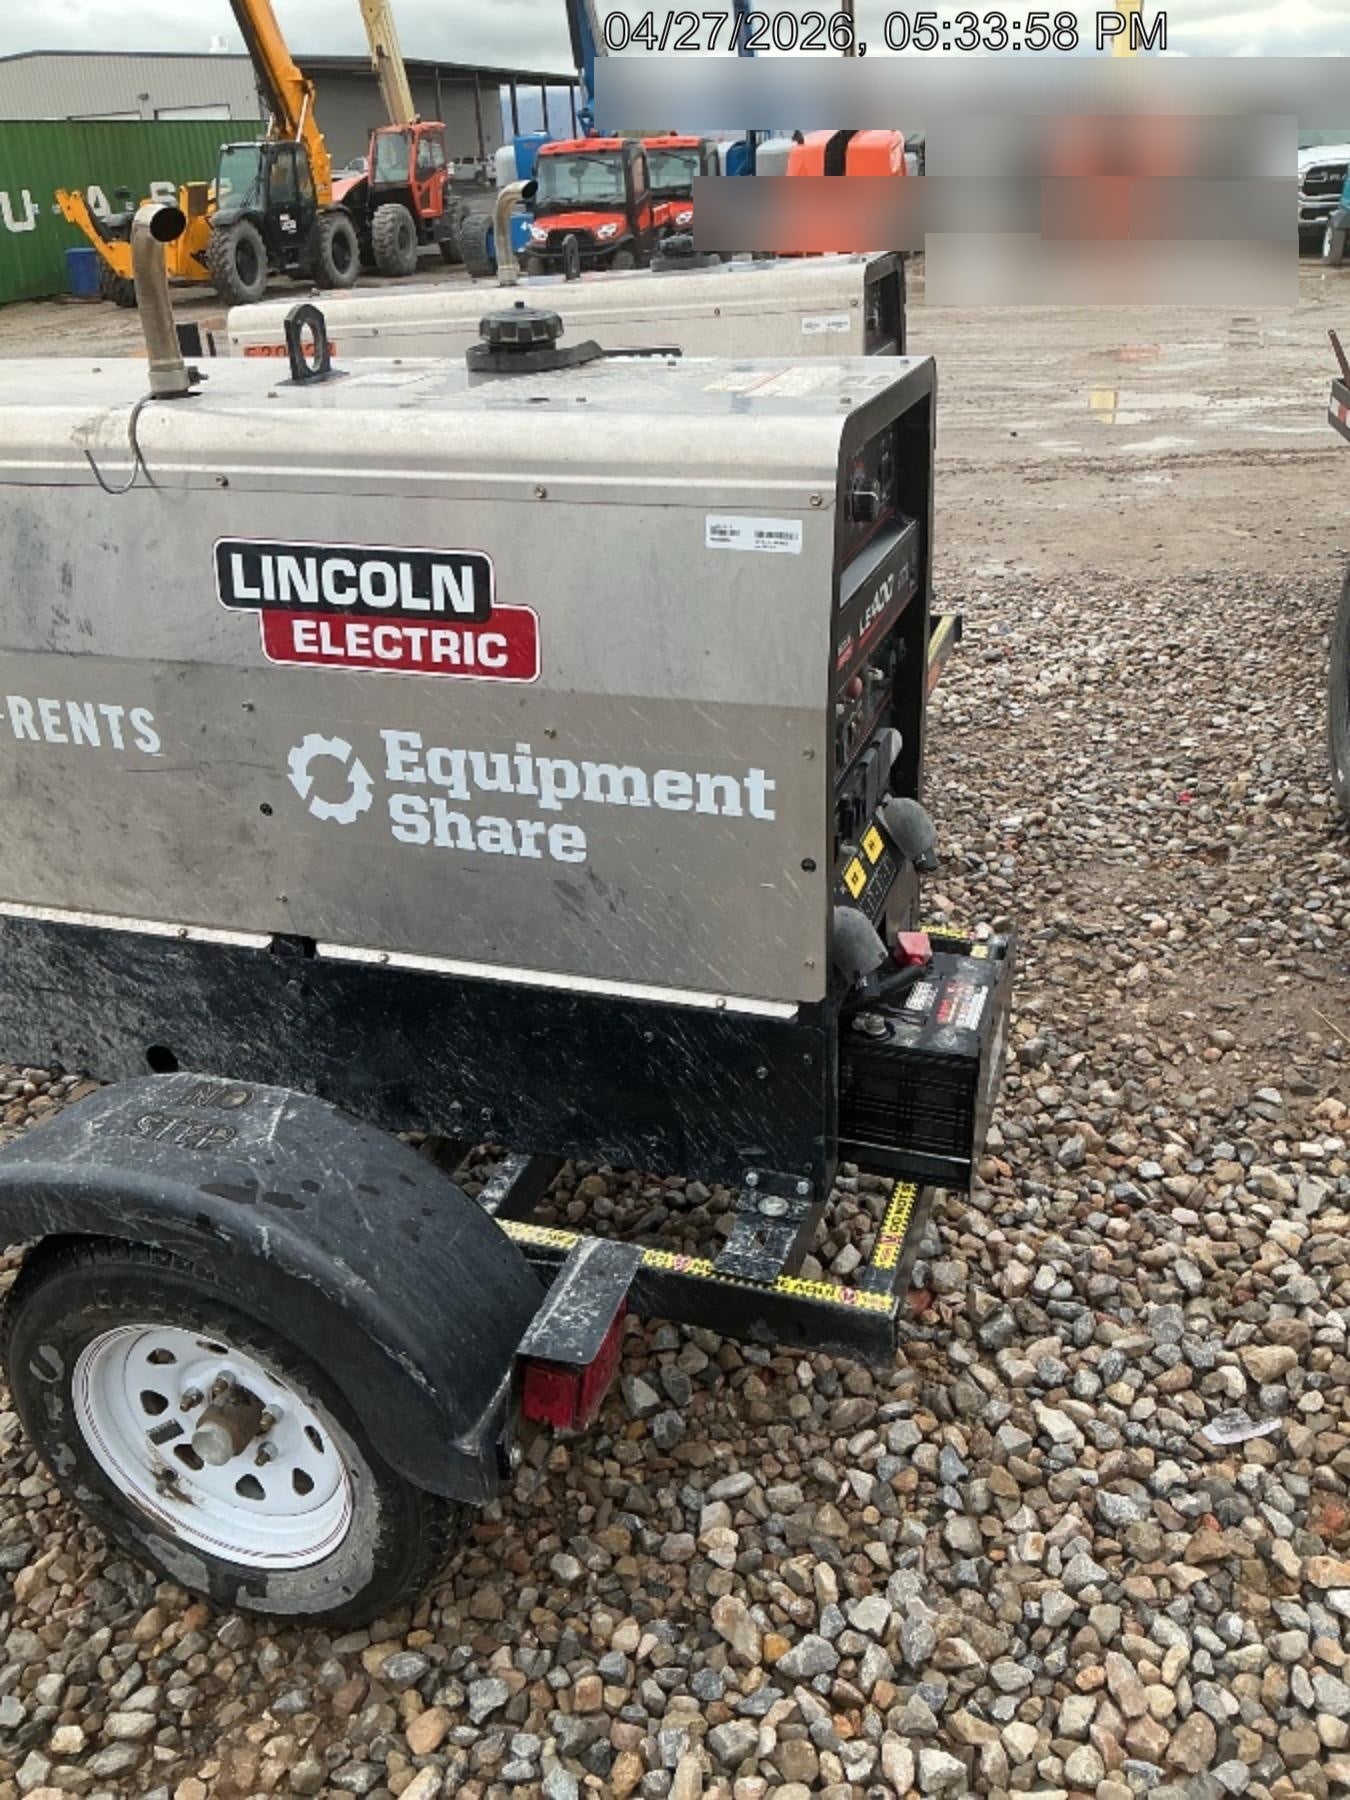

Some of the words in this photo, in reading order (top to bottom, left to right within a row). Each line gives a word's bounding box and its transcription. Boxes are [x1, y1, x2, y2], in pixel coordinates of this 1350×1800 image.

[229, 552, 476, 615] LINCOLN
[292, 618, 509, 669] ELECTRIC
[379, 729, 777, 821] Equipment
[387, 792, 588, 864] Share
